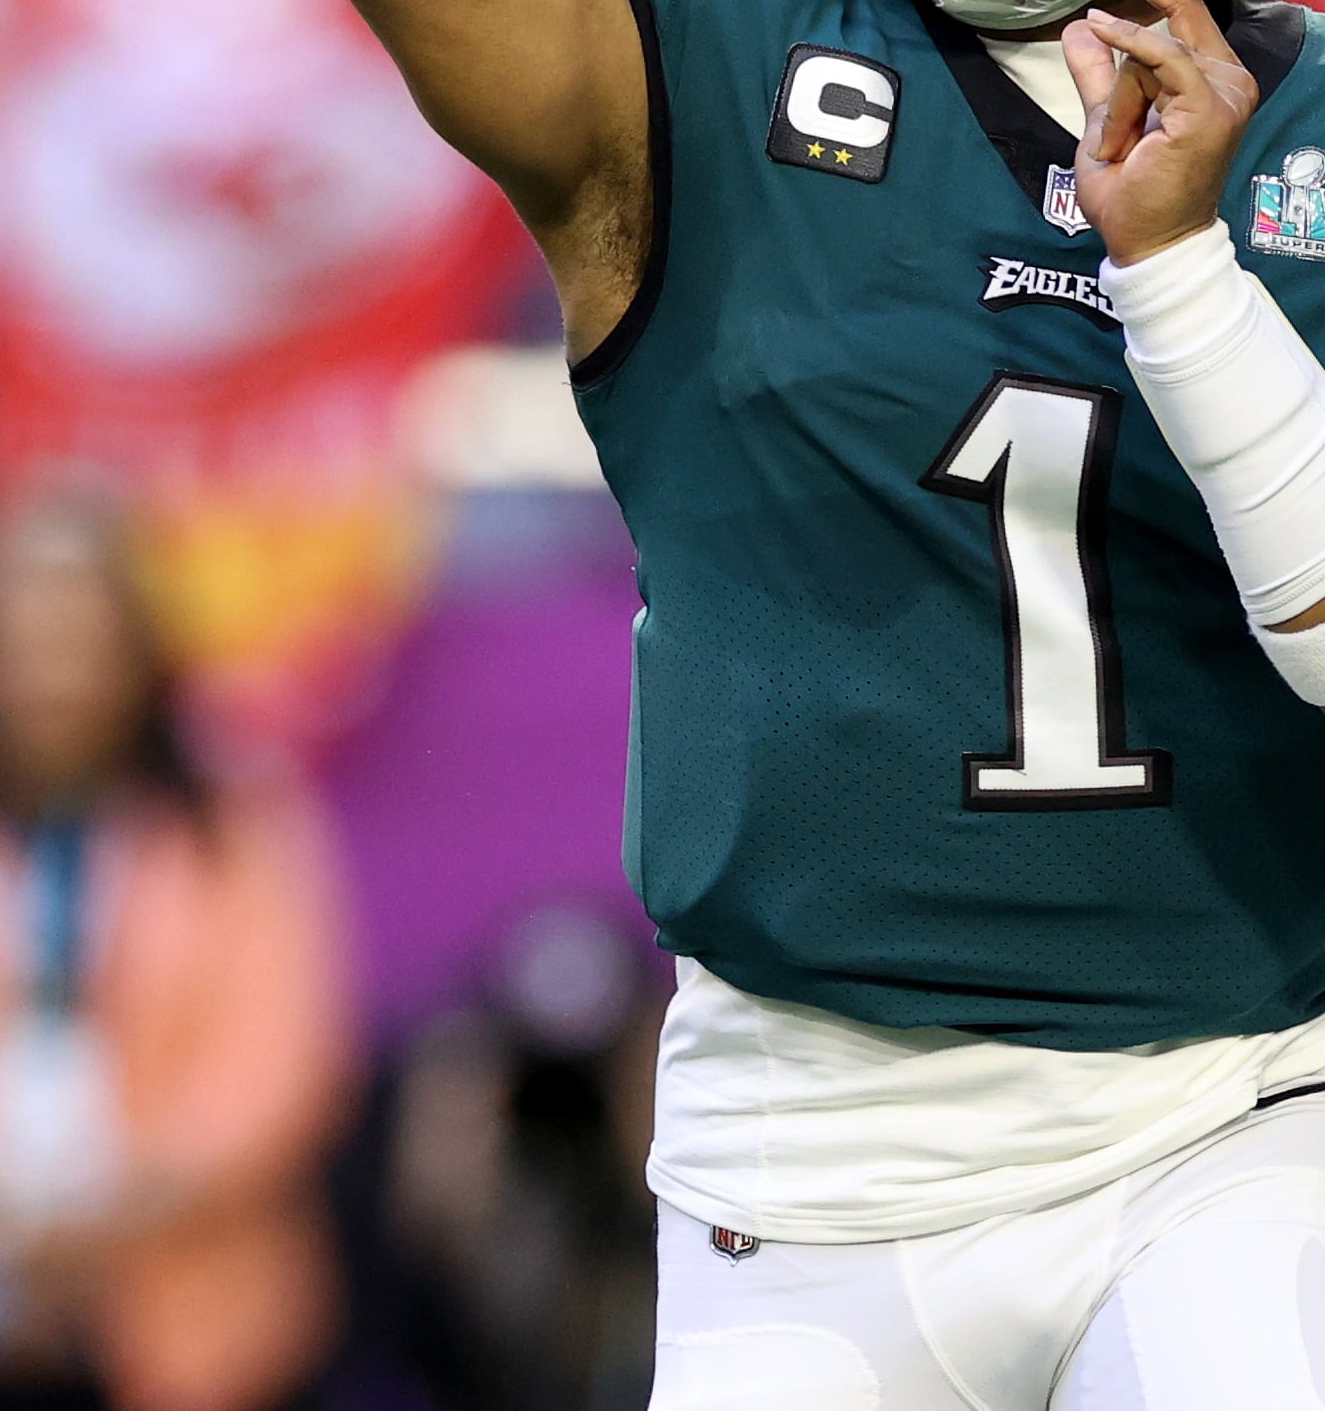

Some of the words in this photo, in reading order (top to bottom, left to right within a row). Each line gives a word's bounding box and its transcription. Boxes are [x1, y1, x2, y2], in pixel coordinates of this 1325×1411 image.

[787, 56, 894, 148] C
[1270, 236, 1325, 252] SUPER
[931, 378, 1160, 802] 1
